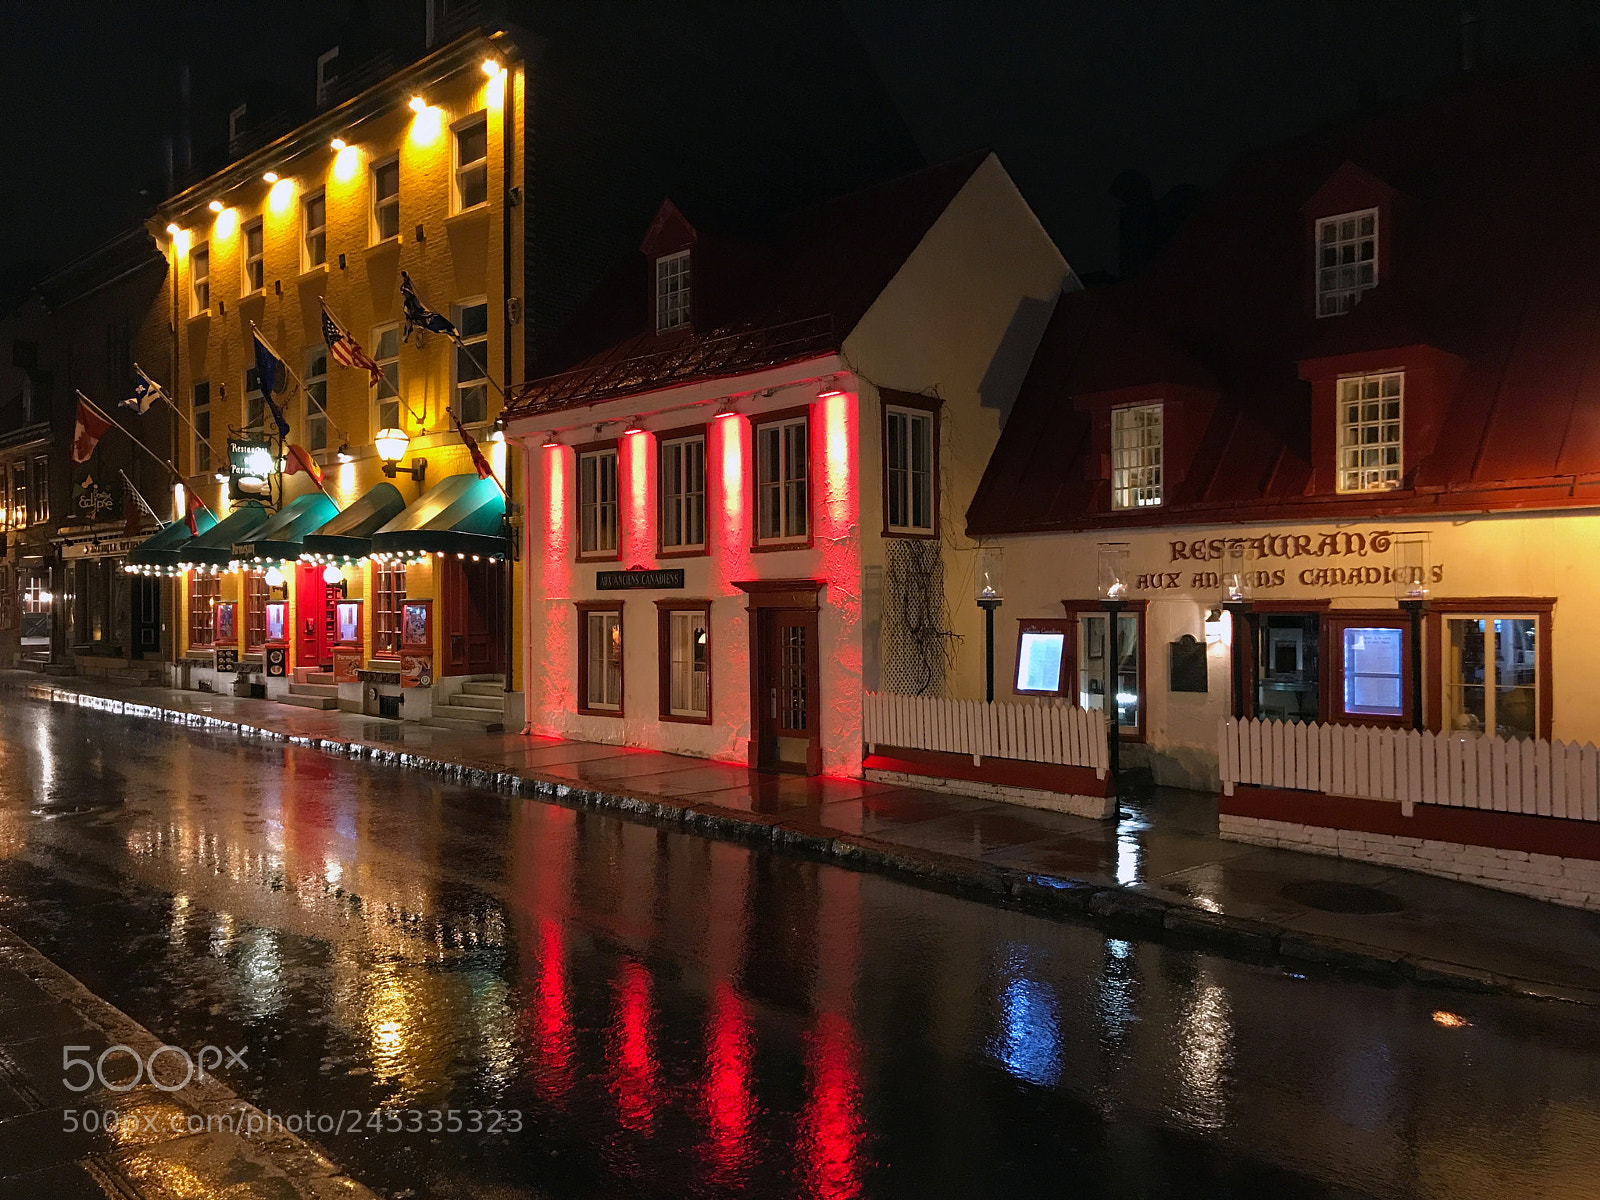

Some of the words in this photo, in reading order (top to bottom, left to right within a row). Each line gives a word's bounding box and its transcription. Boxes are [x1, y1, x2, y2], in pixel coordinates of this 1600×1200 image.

[1169, 531, 1391, 563] RESTAURANT
[613, 575, 639, 586] ANCIENS
[641, 573, 679, 585] CANADIENS
[1136, 570, 1182, 591] AUX
[1298, 564, 1444, 587] CANADIENS
